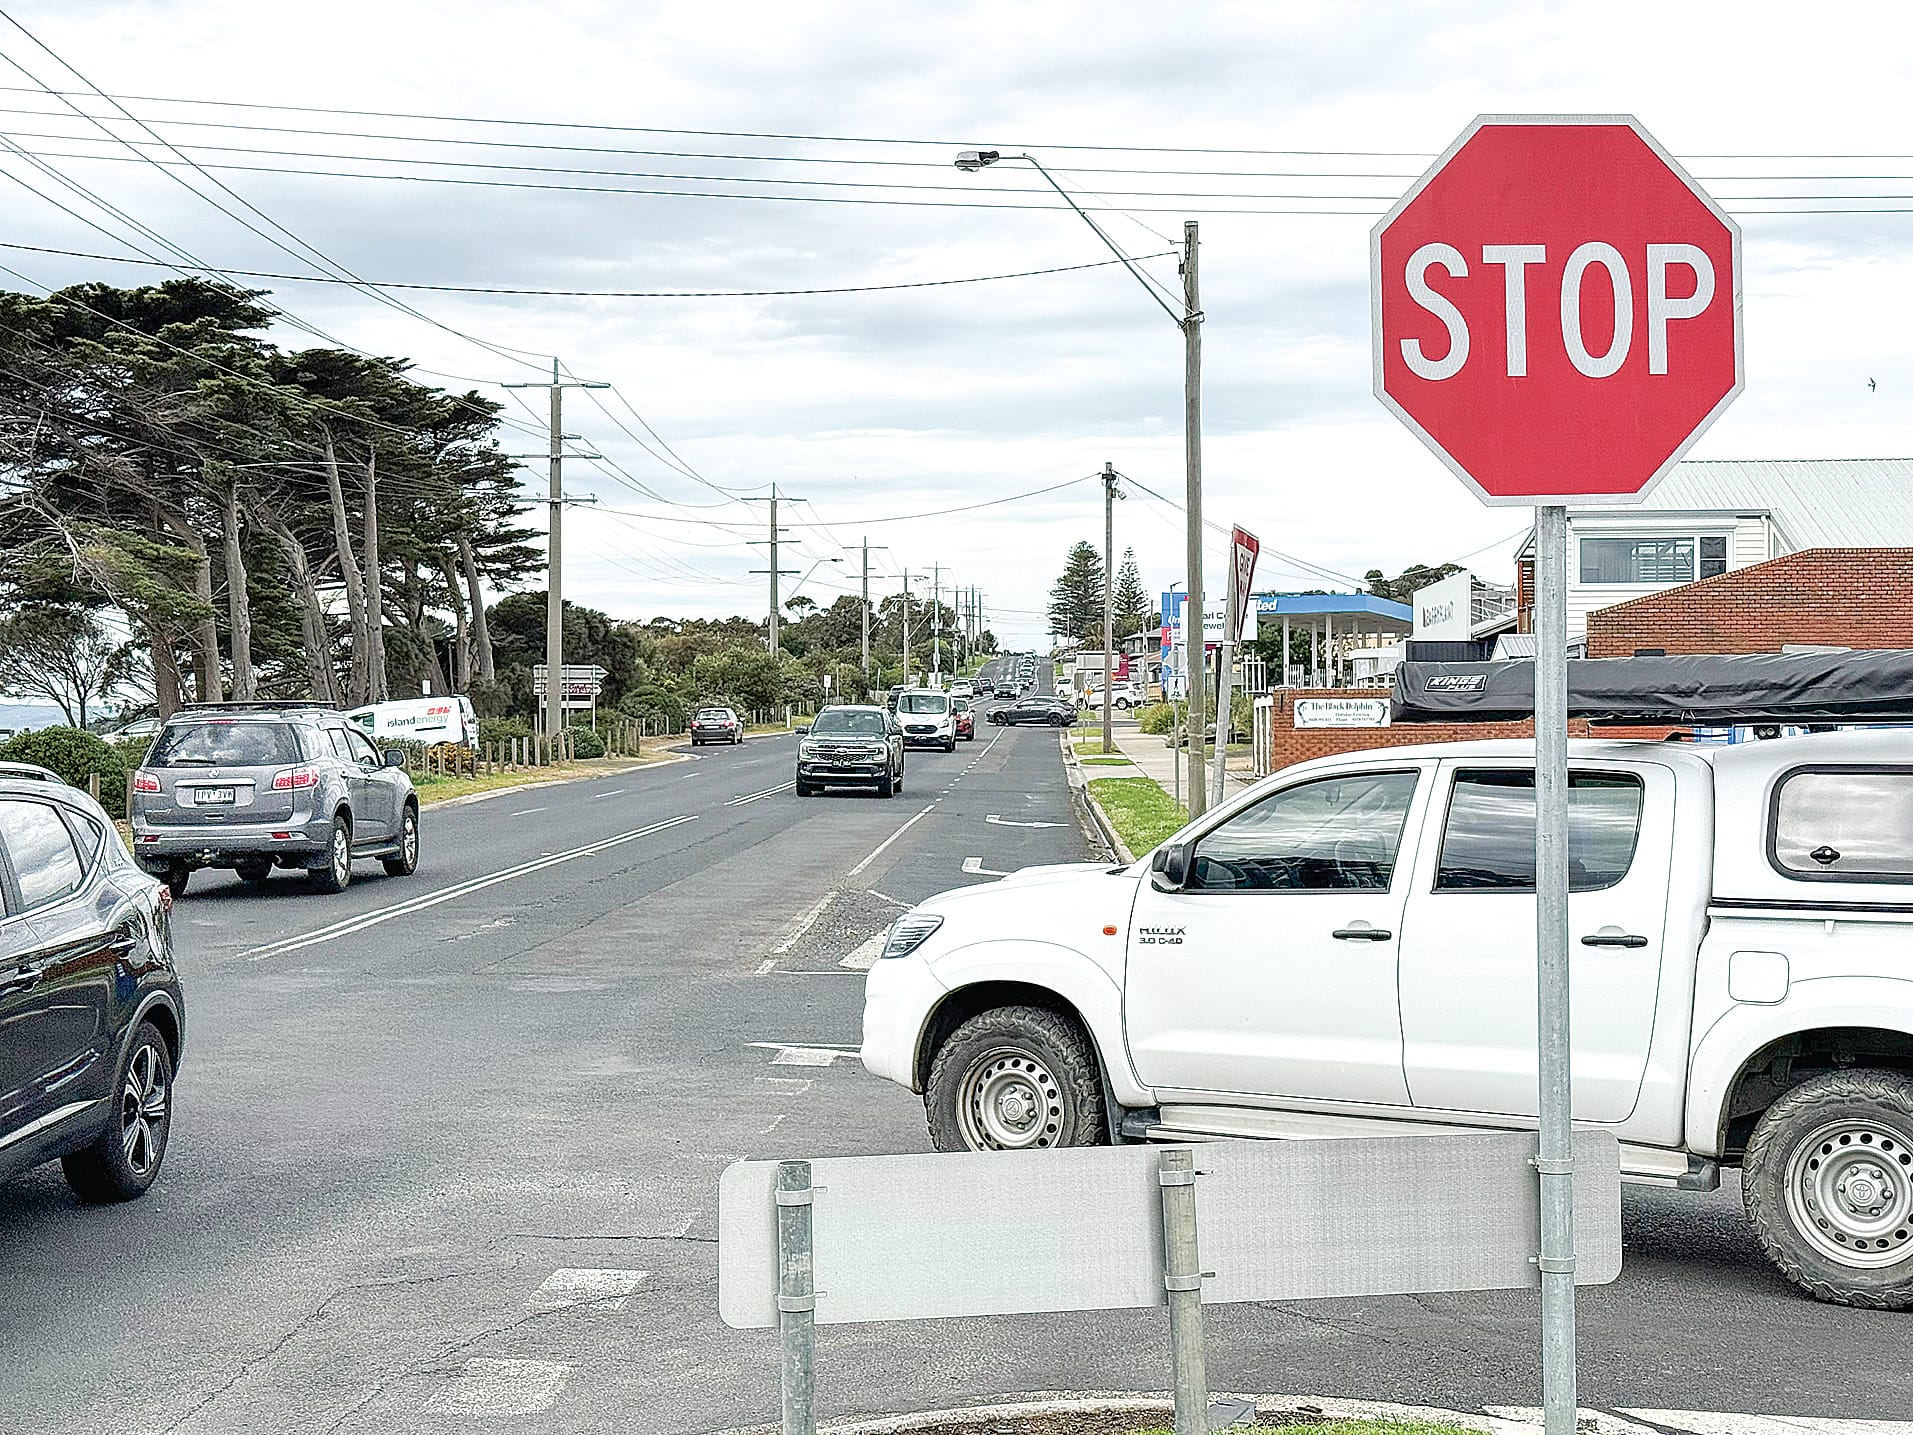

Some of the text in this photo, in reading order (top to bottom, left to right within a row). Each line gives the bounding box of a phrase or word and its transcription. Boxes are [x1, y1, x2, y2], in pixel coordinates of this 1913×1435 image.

[1400, 241, 1716, 381] STOP
[1257, 599, 1278, 611] ted
[1430, 675, 1481, 686] KINGS
[1310, 702, 1373, 712] The Black Dolphin
[1139, 925, 1187, 936] HILUX
